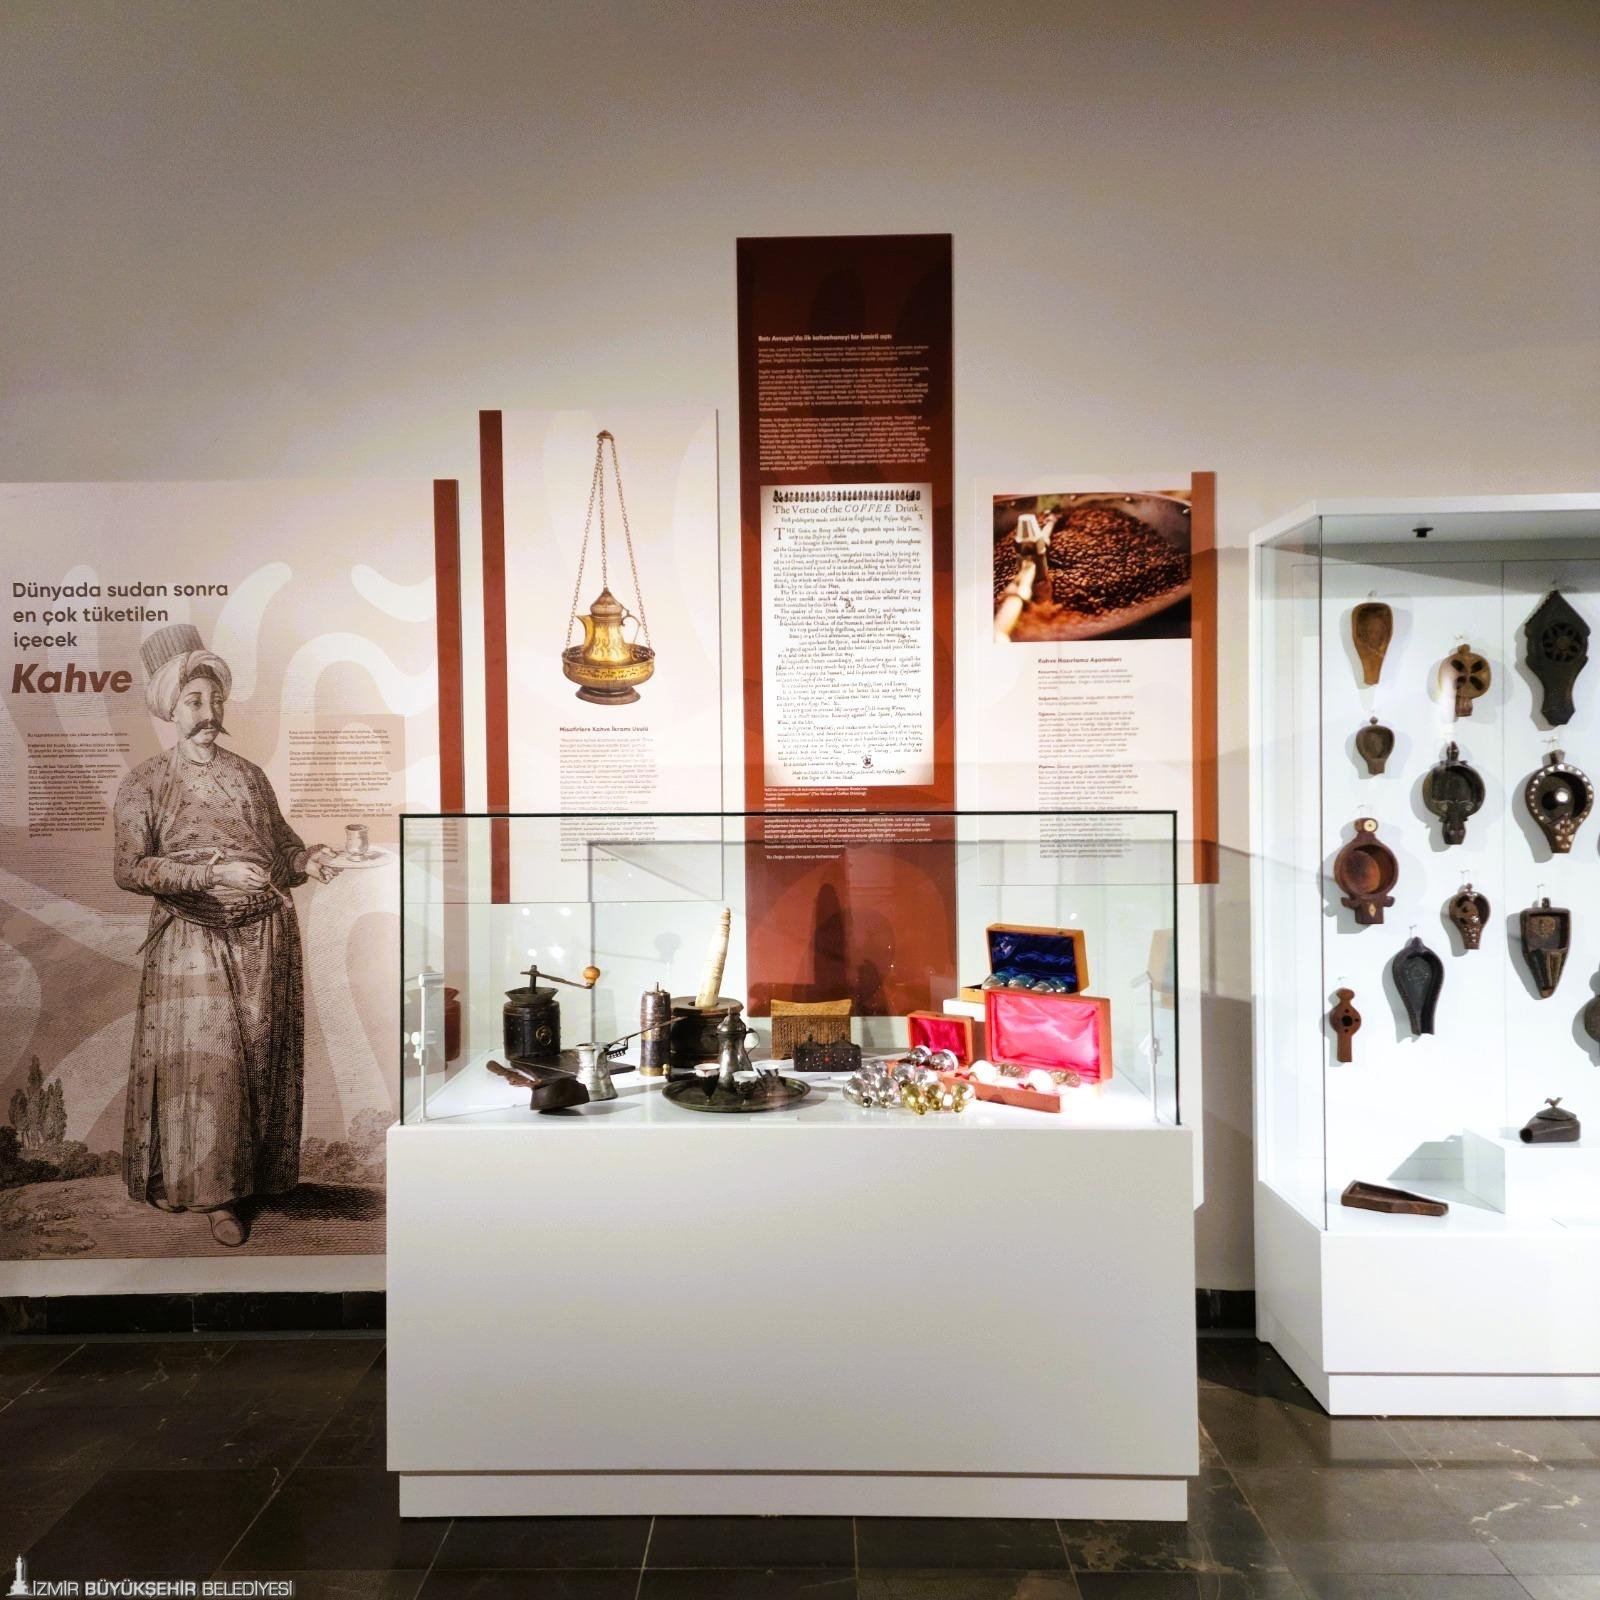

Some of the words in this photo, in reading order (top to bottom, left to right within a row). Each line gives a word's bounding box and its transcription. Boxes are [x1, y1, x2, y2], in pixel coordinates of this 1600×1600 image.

[772, 504, 790, 514] The
[792, 504, 819, 514] Vertue
[820, 503, 829, 514] of
[830, 504, 843, 514] the
[844, 503, 892, 514] COFFEE
[12, 581, 101, 601] Dünyada
[107, 581, 168, 598] sudan
[173, 584, 229, 597] sonra
[12, 610, 36, 623] en
[42, 606, 78, 626] çok
[82, 605, 169, 622] tüketilen
[13, 631, 78, 651] içecek
[11, 663, 133, 694] Kahve
